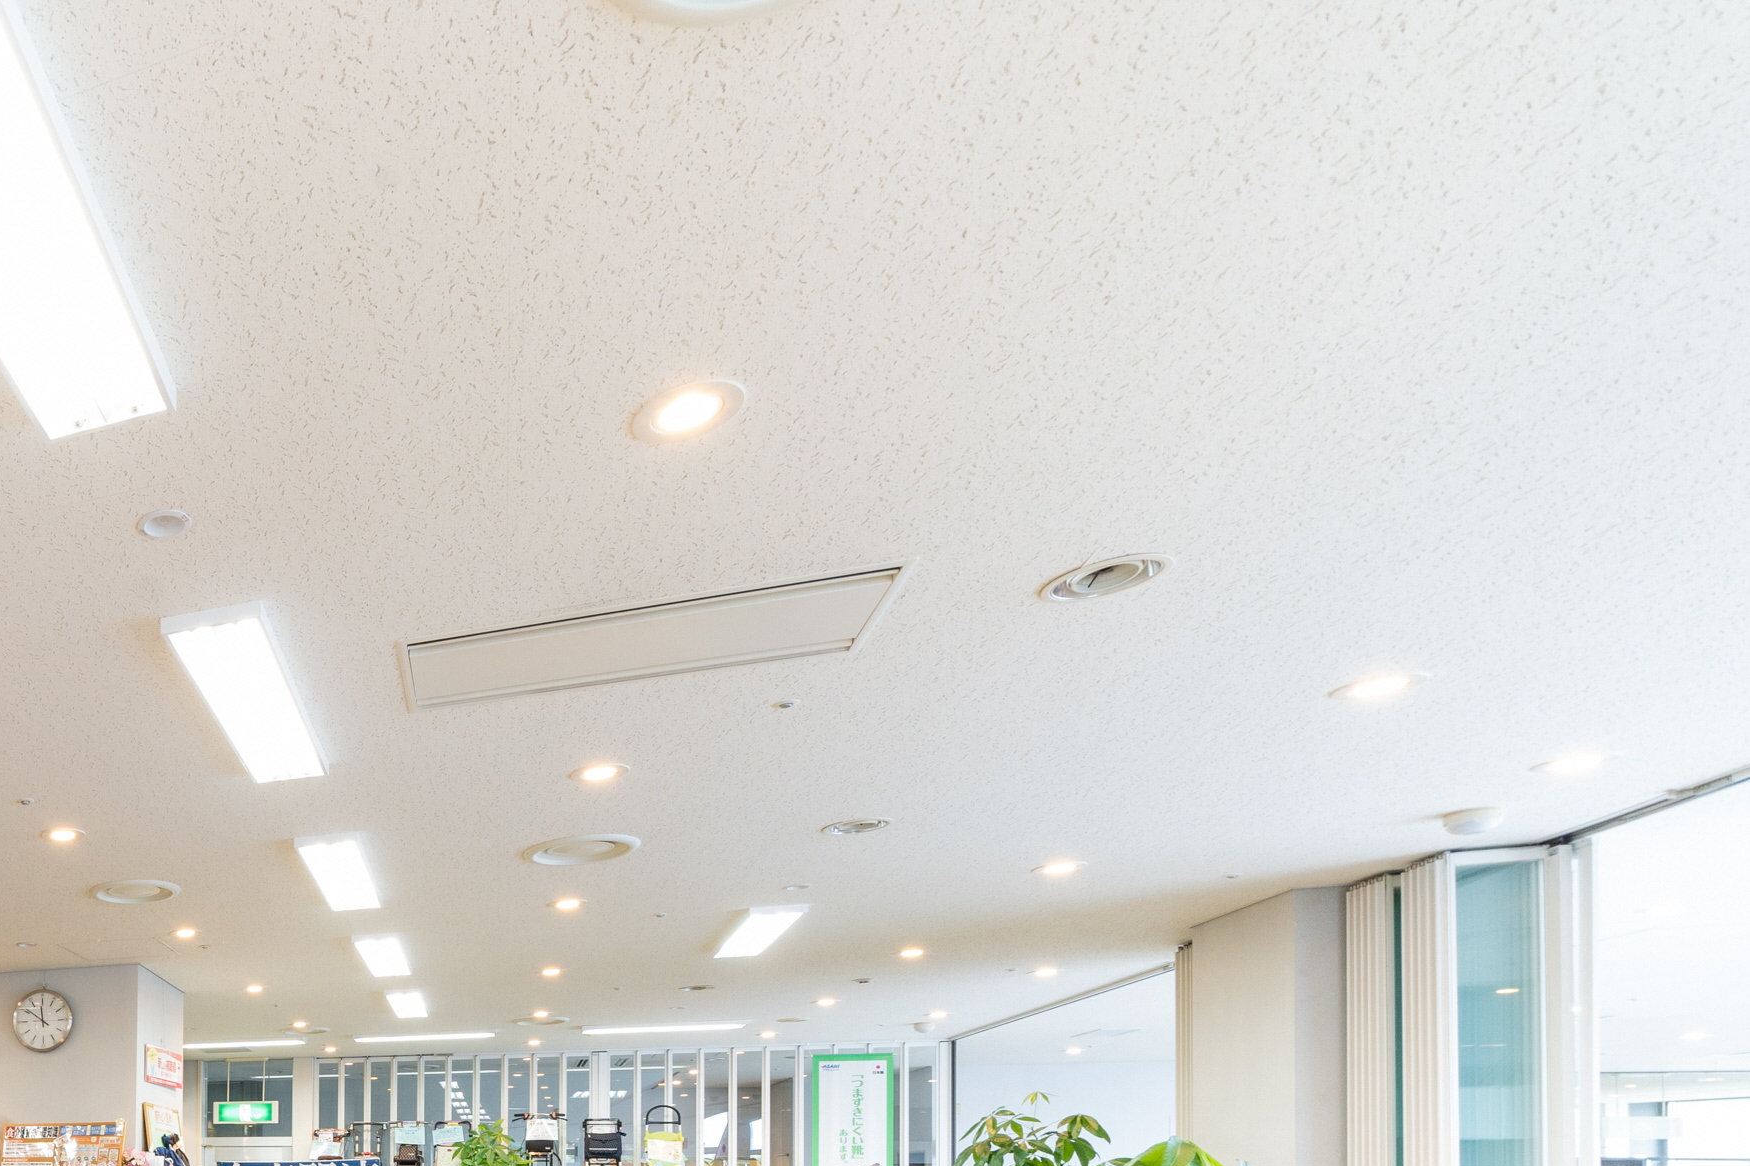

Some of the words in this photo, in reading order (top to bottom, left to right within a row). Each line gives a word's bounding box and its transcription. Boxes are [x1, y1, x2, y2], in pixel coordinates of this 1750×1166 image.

[839, 1129, 848, 1164] あります。
[851, 1074, 864, 1160] 「つまずきにくい靴」
